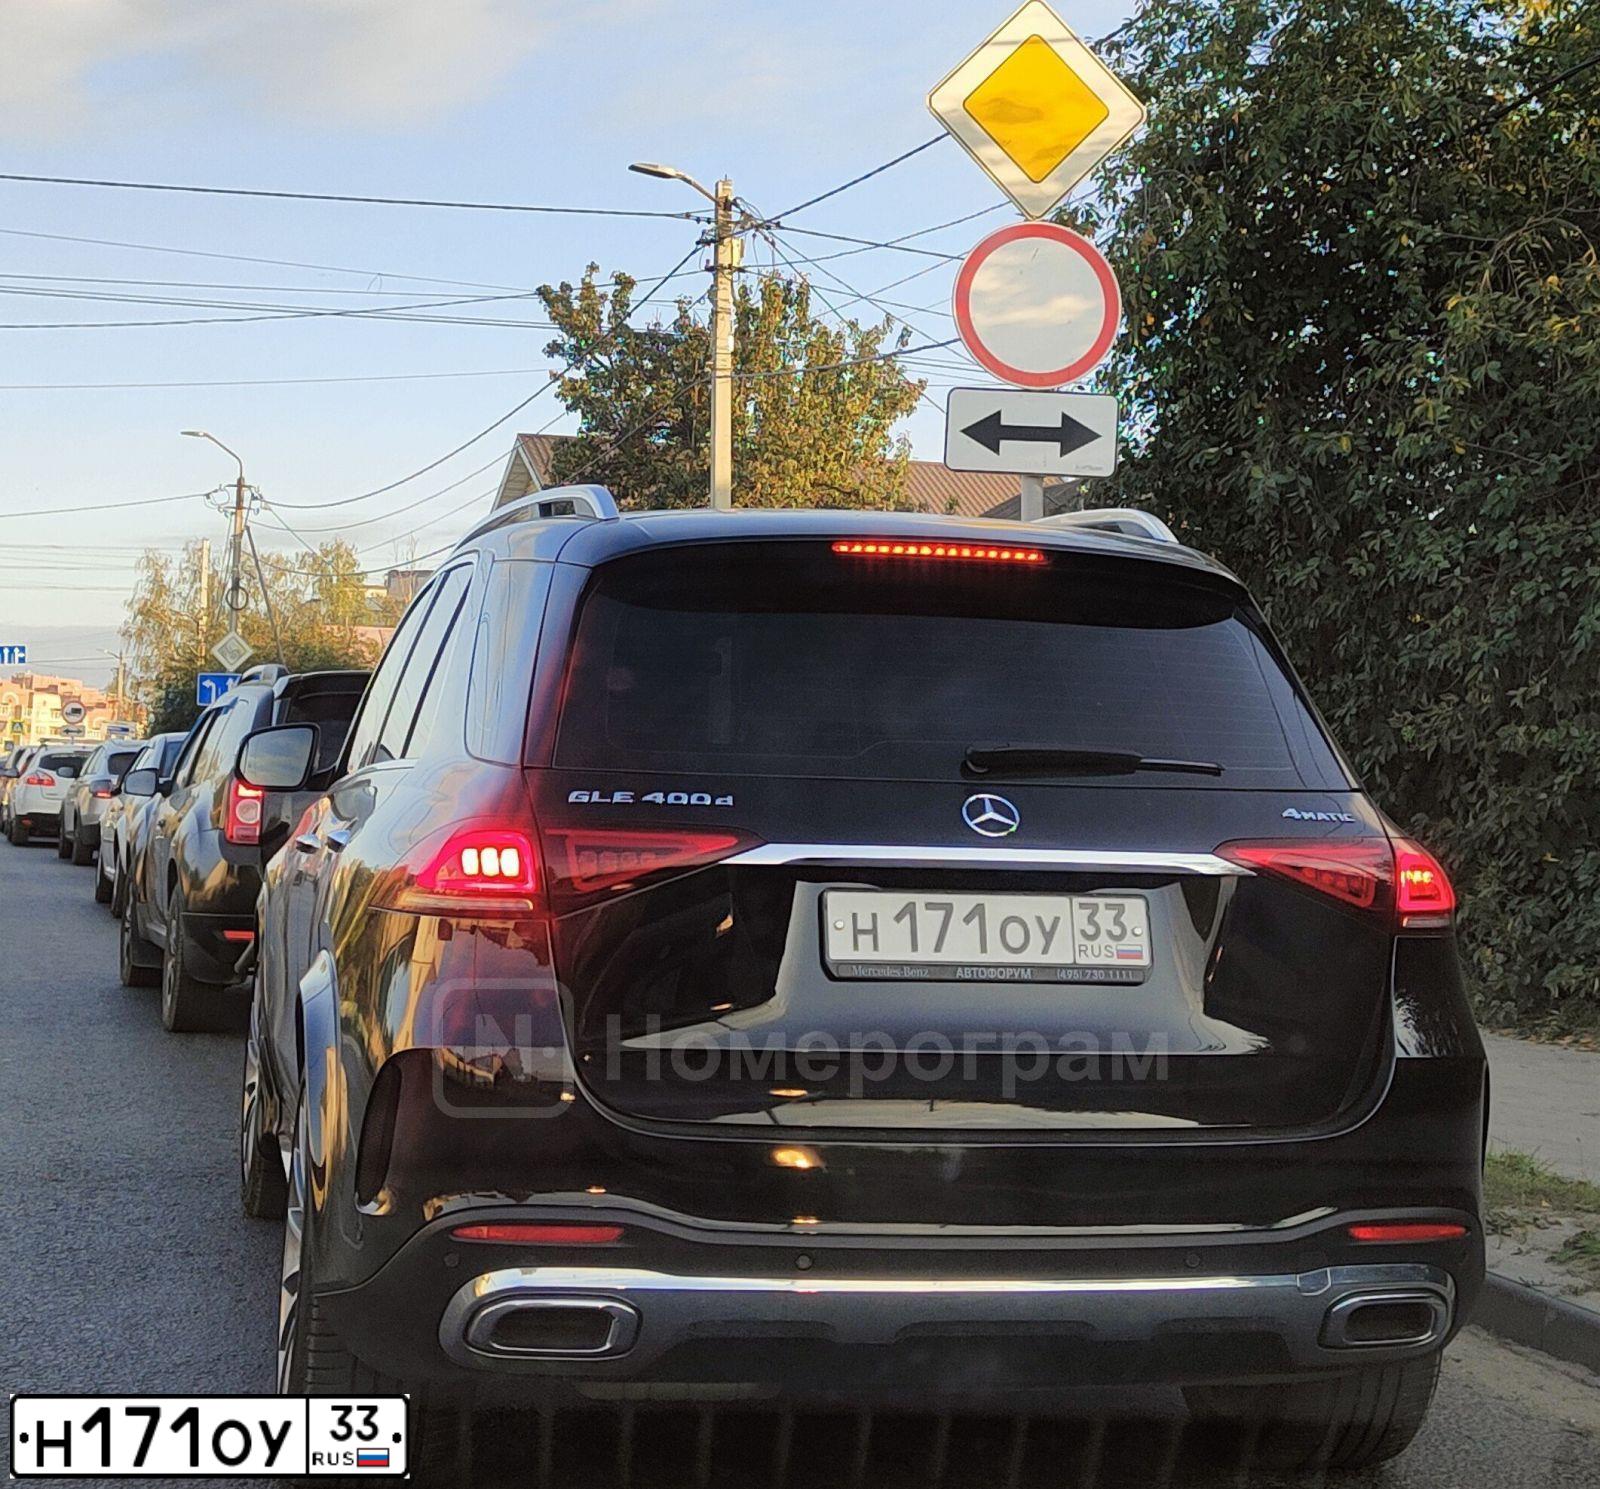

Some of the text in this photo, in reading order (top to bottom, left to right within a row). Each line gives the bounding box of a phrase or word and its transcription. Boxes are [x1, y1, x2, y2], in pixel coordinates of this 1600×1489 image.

[568, 791, 734, 806] GLE 400d
[1281, 808, 1356, 822] 4MATIC
[1078, 902, 1128, 941] 33
[1078, 944, 1115, 958] RUS
[852, 965, 930, 978] Mercedes-Benz
[956, 967, 1032, 980] АВТОФОРУМ
